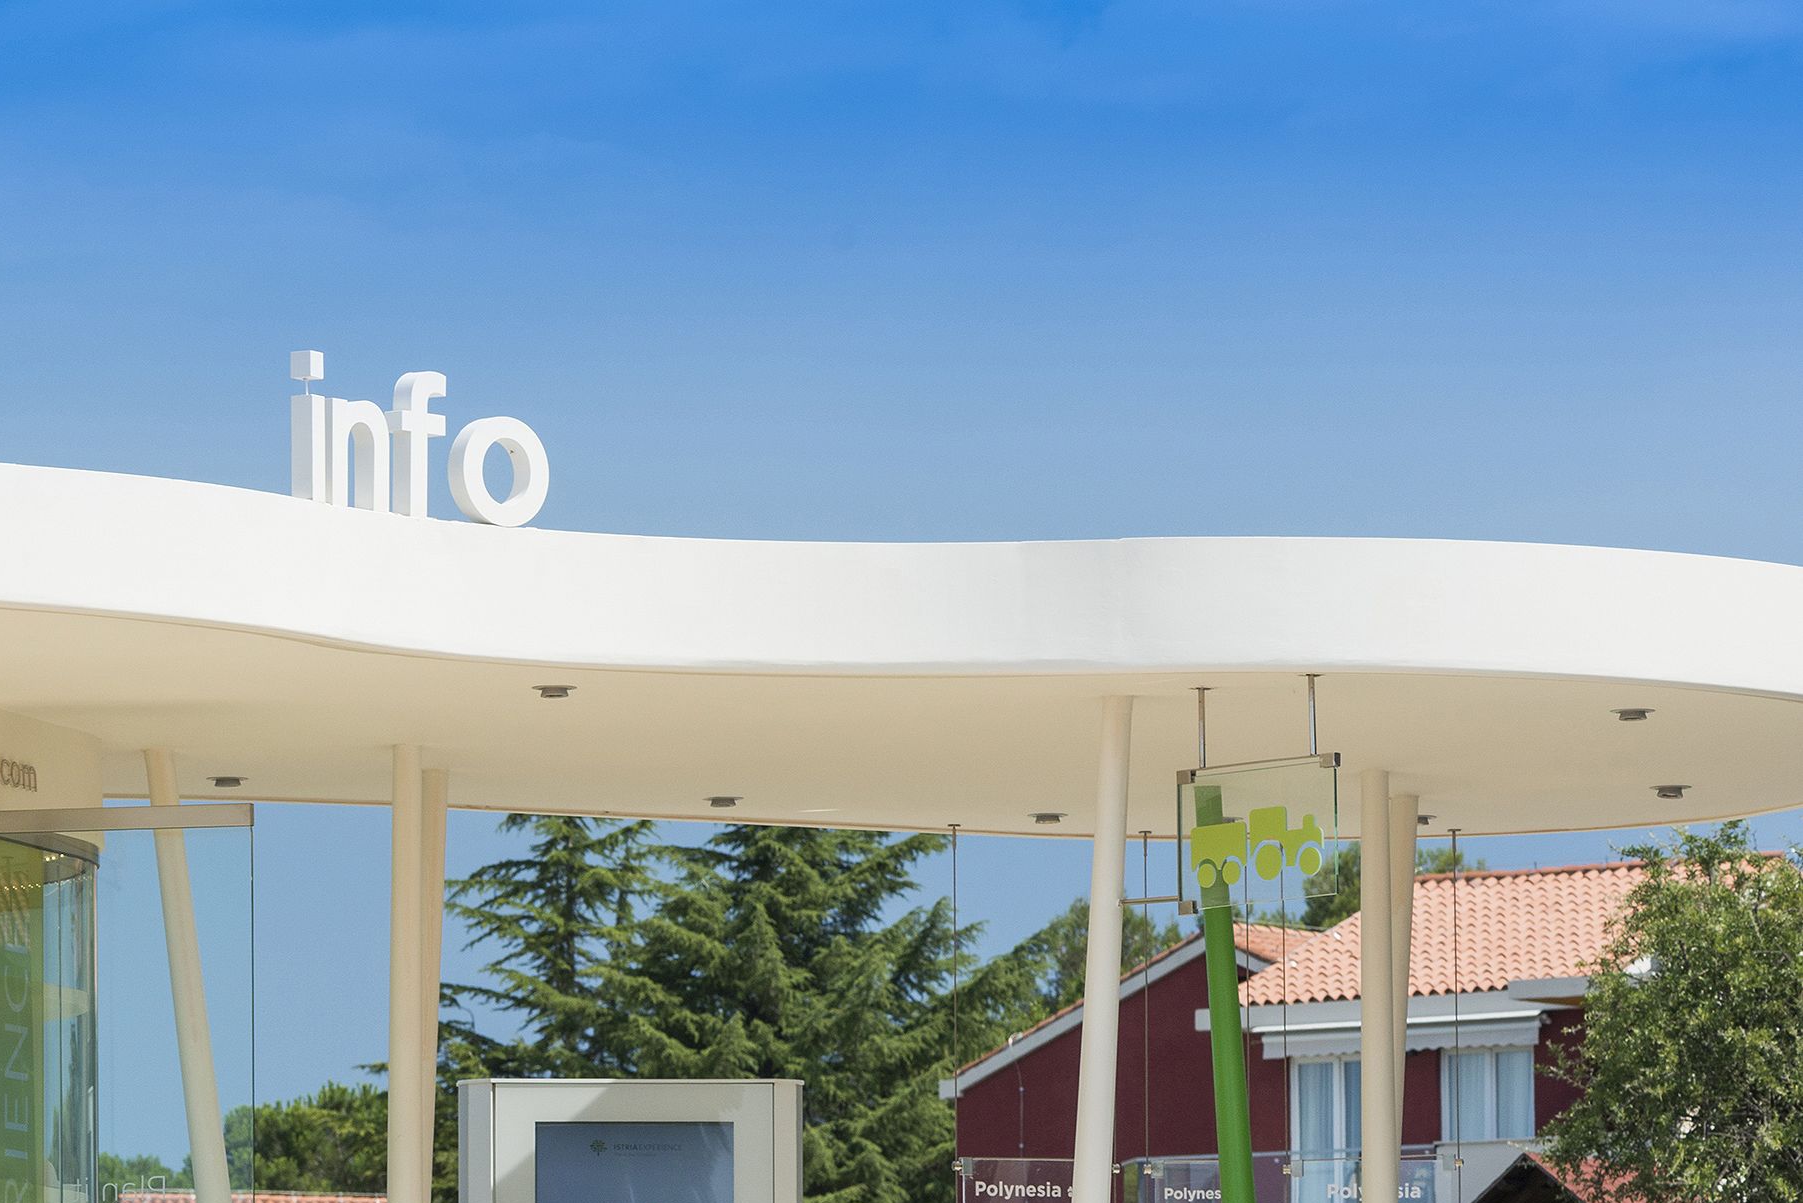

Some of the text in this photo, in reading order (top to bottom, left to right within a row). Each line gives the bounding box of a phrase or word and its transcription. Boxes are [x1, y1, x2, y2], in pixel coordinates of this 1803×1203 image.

[290, 350, 550, 528] info
[975, 1181, 1062, 1200] Polynesia
[1164, 1187, 1222, 1202] Polynes
